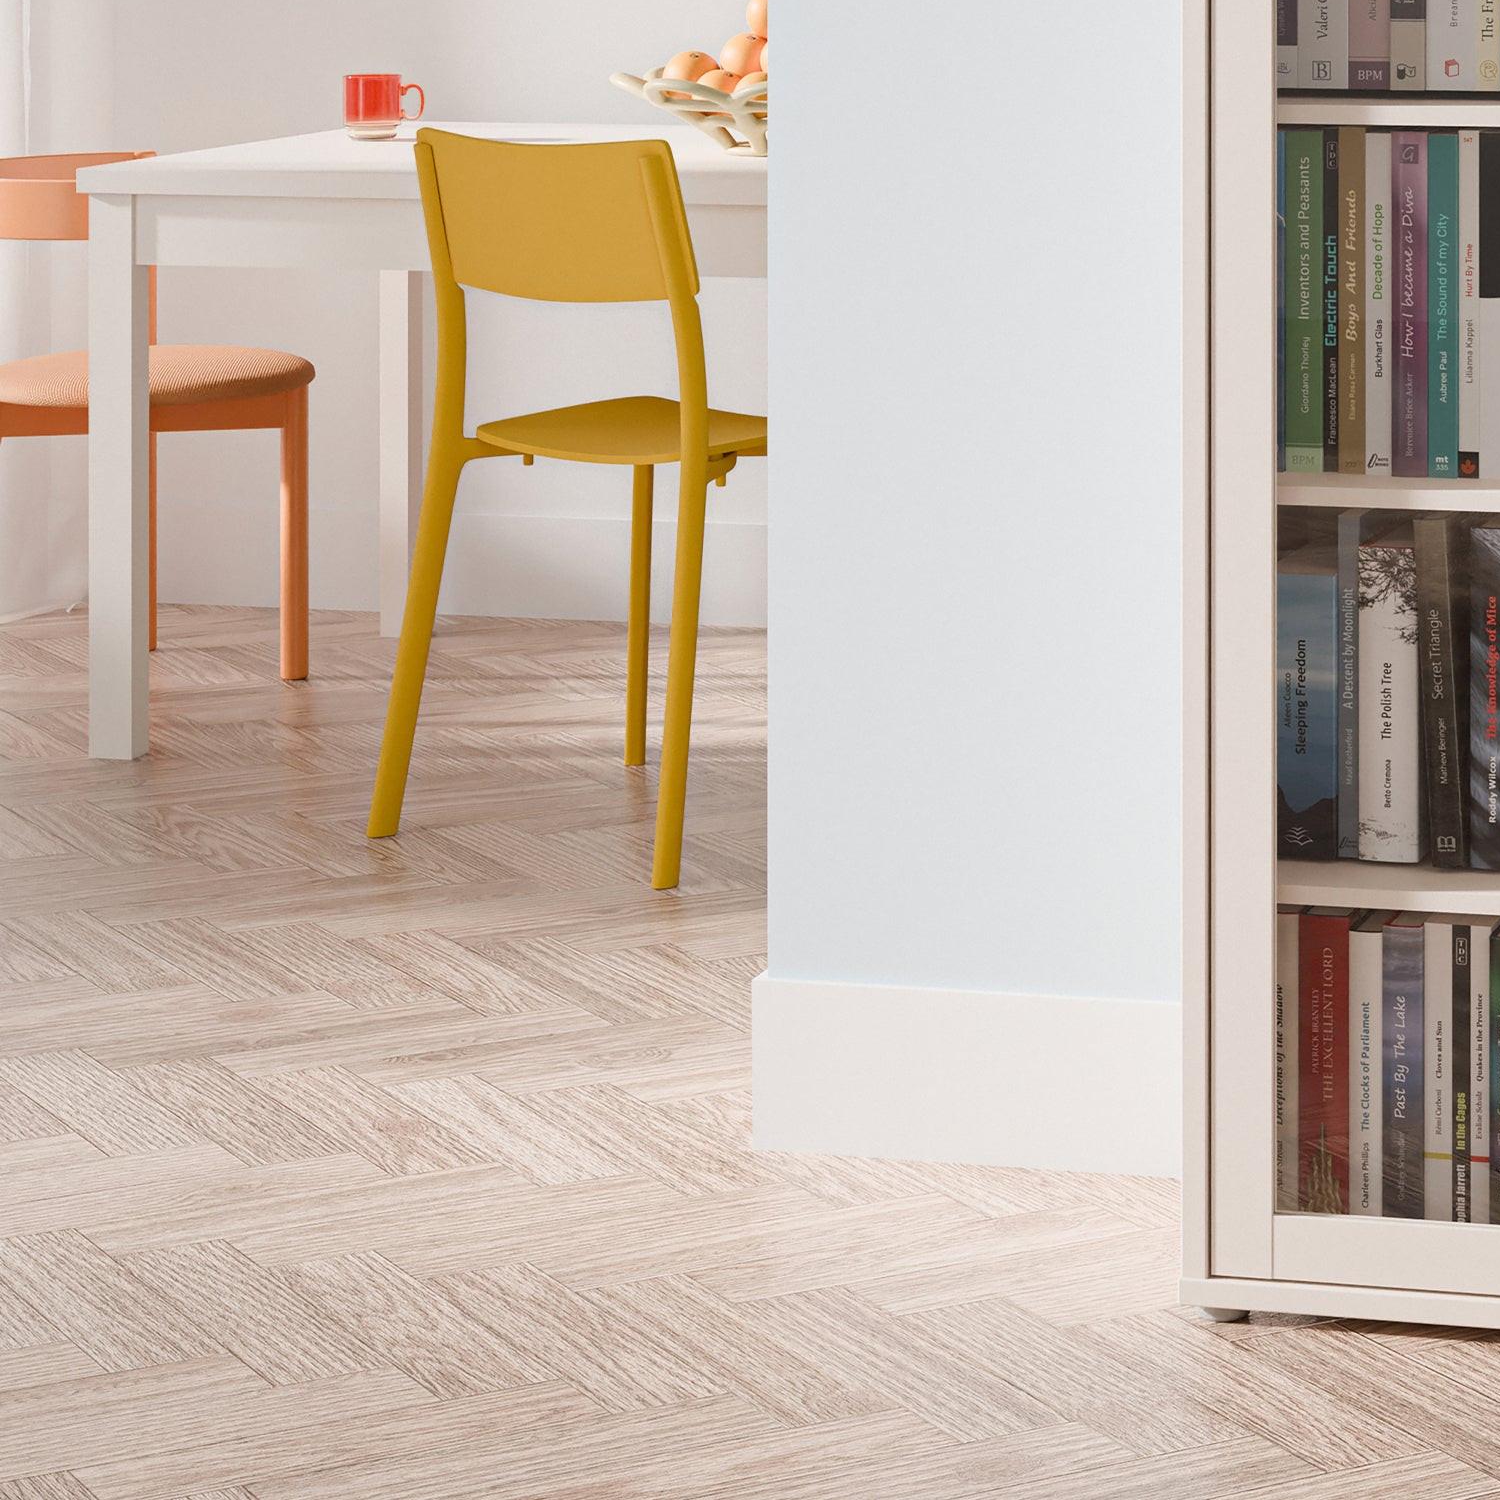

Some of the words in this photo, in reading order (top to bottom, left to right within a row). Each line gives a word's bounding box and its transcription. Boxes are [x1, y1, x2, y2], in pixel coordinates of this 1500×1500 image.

[1481, 18, 1494, 41] The
[1358, 70, 1383, 81] BPM
[1298, 157, 1310, 219] Peasants
[1372, 204, 1384, 235] Hope
[1401, 187, 1413, 227] Diva
[1298, 225, 1309, 249] and
[1405, 232, 1413, 243] a
[1437, 214, 1449, 237] City
[1372, 238, 1382, 251] of
[1439, 240, 1449, 258] my
[1465, 244, 1473, 263] Time
[1325, 235, 1336, 284] Touch
[1436, 262, 1447, 274] of
[1465, 266, 1474, 276] By
[1298, 254, 1310, 319] Inventors
[1372, 254, 1382, 299] Decade
[1401, 247, 1414, 306] became
[1437, 278, 1447, 316] Sound
[1325, 290, 1336, 346] Electric
[1437, 318, 1447, 340] The
[1401, 321, 1414, 358] How
[1486, 596, 1497, 625] Mice
[1427, 610, 1442, 659] Triangle
[1486, 628, 1497, 641] of
[1295, 640, 1306, 696] Freedom
[1381, 662, 1392, 685] Tree
[1432, 662, 1443, 699] Secret
[1486, 644, 1500, 714] Knowledge
[1380, 688, 1392, 718] Polish
[1296, 701, 1308, 754] Sleeping
[1381, 722, 1392, 740] The
[1488, 719, 1498, 739] The
[1323, 947, 1333, 987] LORD
[1393, 996, 1405, 1027] Lake
[1323, 990, 1333, 1068] EXCELLENT
[1360, 1002, 1370, 1058] Parliament
[1394, 1034, 1405, 1058] The
[1360, 1062, 1370, 1072] of
[1394, 1065, 1409, 1082] By
[1323, 1071, 1333, 1101] THE
[1361, 1076, 1370, 1109] Clocks
[1394, 1088, 1406, 1118] Past
[1456, 1092, 1466, 1121] Cages
[1361, 1112, 1370, 1132] The
[1456, 1123, 1465, 1139] the
[1456, 1140, 1465, 1150] In
